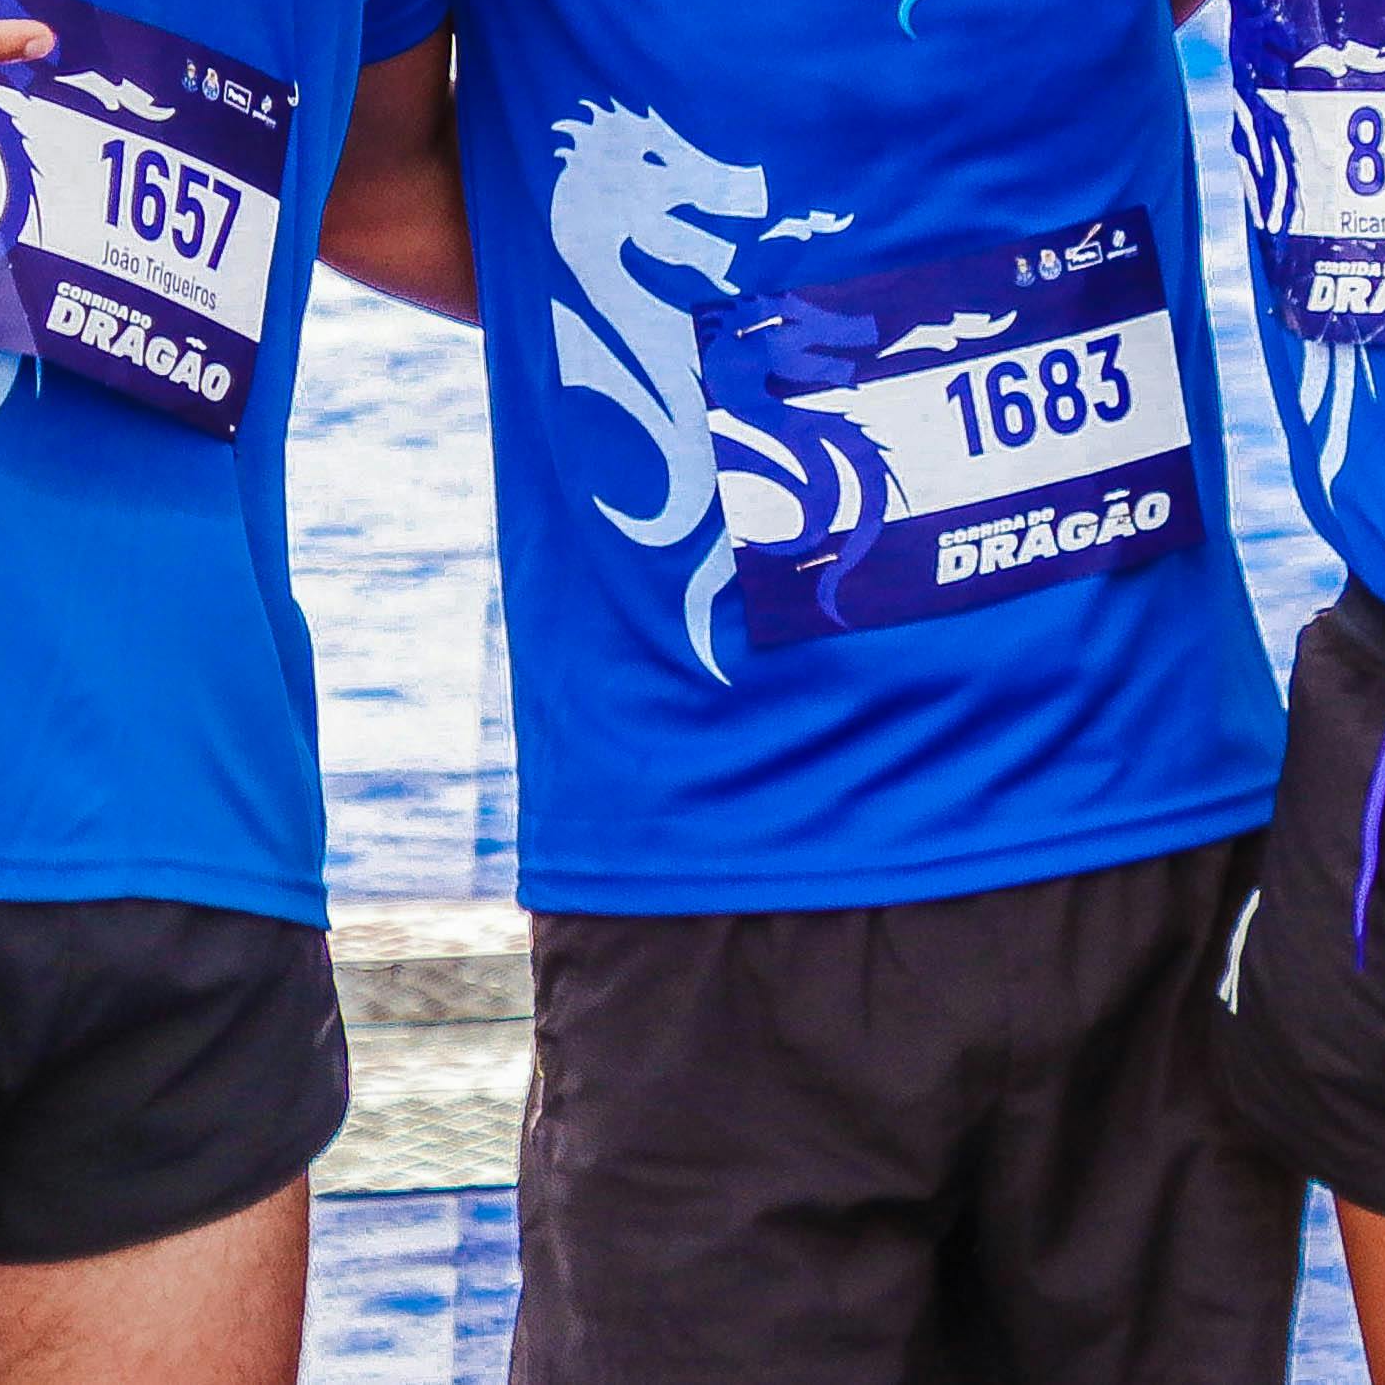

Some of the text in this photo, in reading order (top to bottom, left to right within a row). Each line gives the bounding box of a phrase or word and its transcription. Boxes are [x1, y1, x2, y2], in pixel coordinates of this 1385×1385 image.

[102, 139, 242, 271] 1657
[57, 281, 152, 330] CORRIDA DO
[102, 241, 217, 311] João Trigueiros
[46, 295, 231, 402] DRAGÃO
[946, 333, 1132, 458] 1683
[936, 490, 1171, 585] DRAGÃO
[938, 507, 1055, 548] CORRIDA DO
